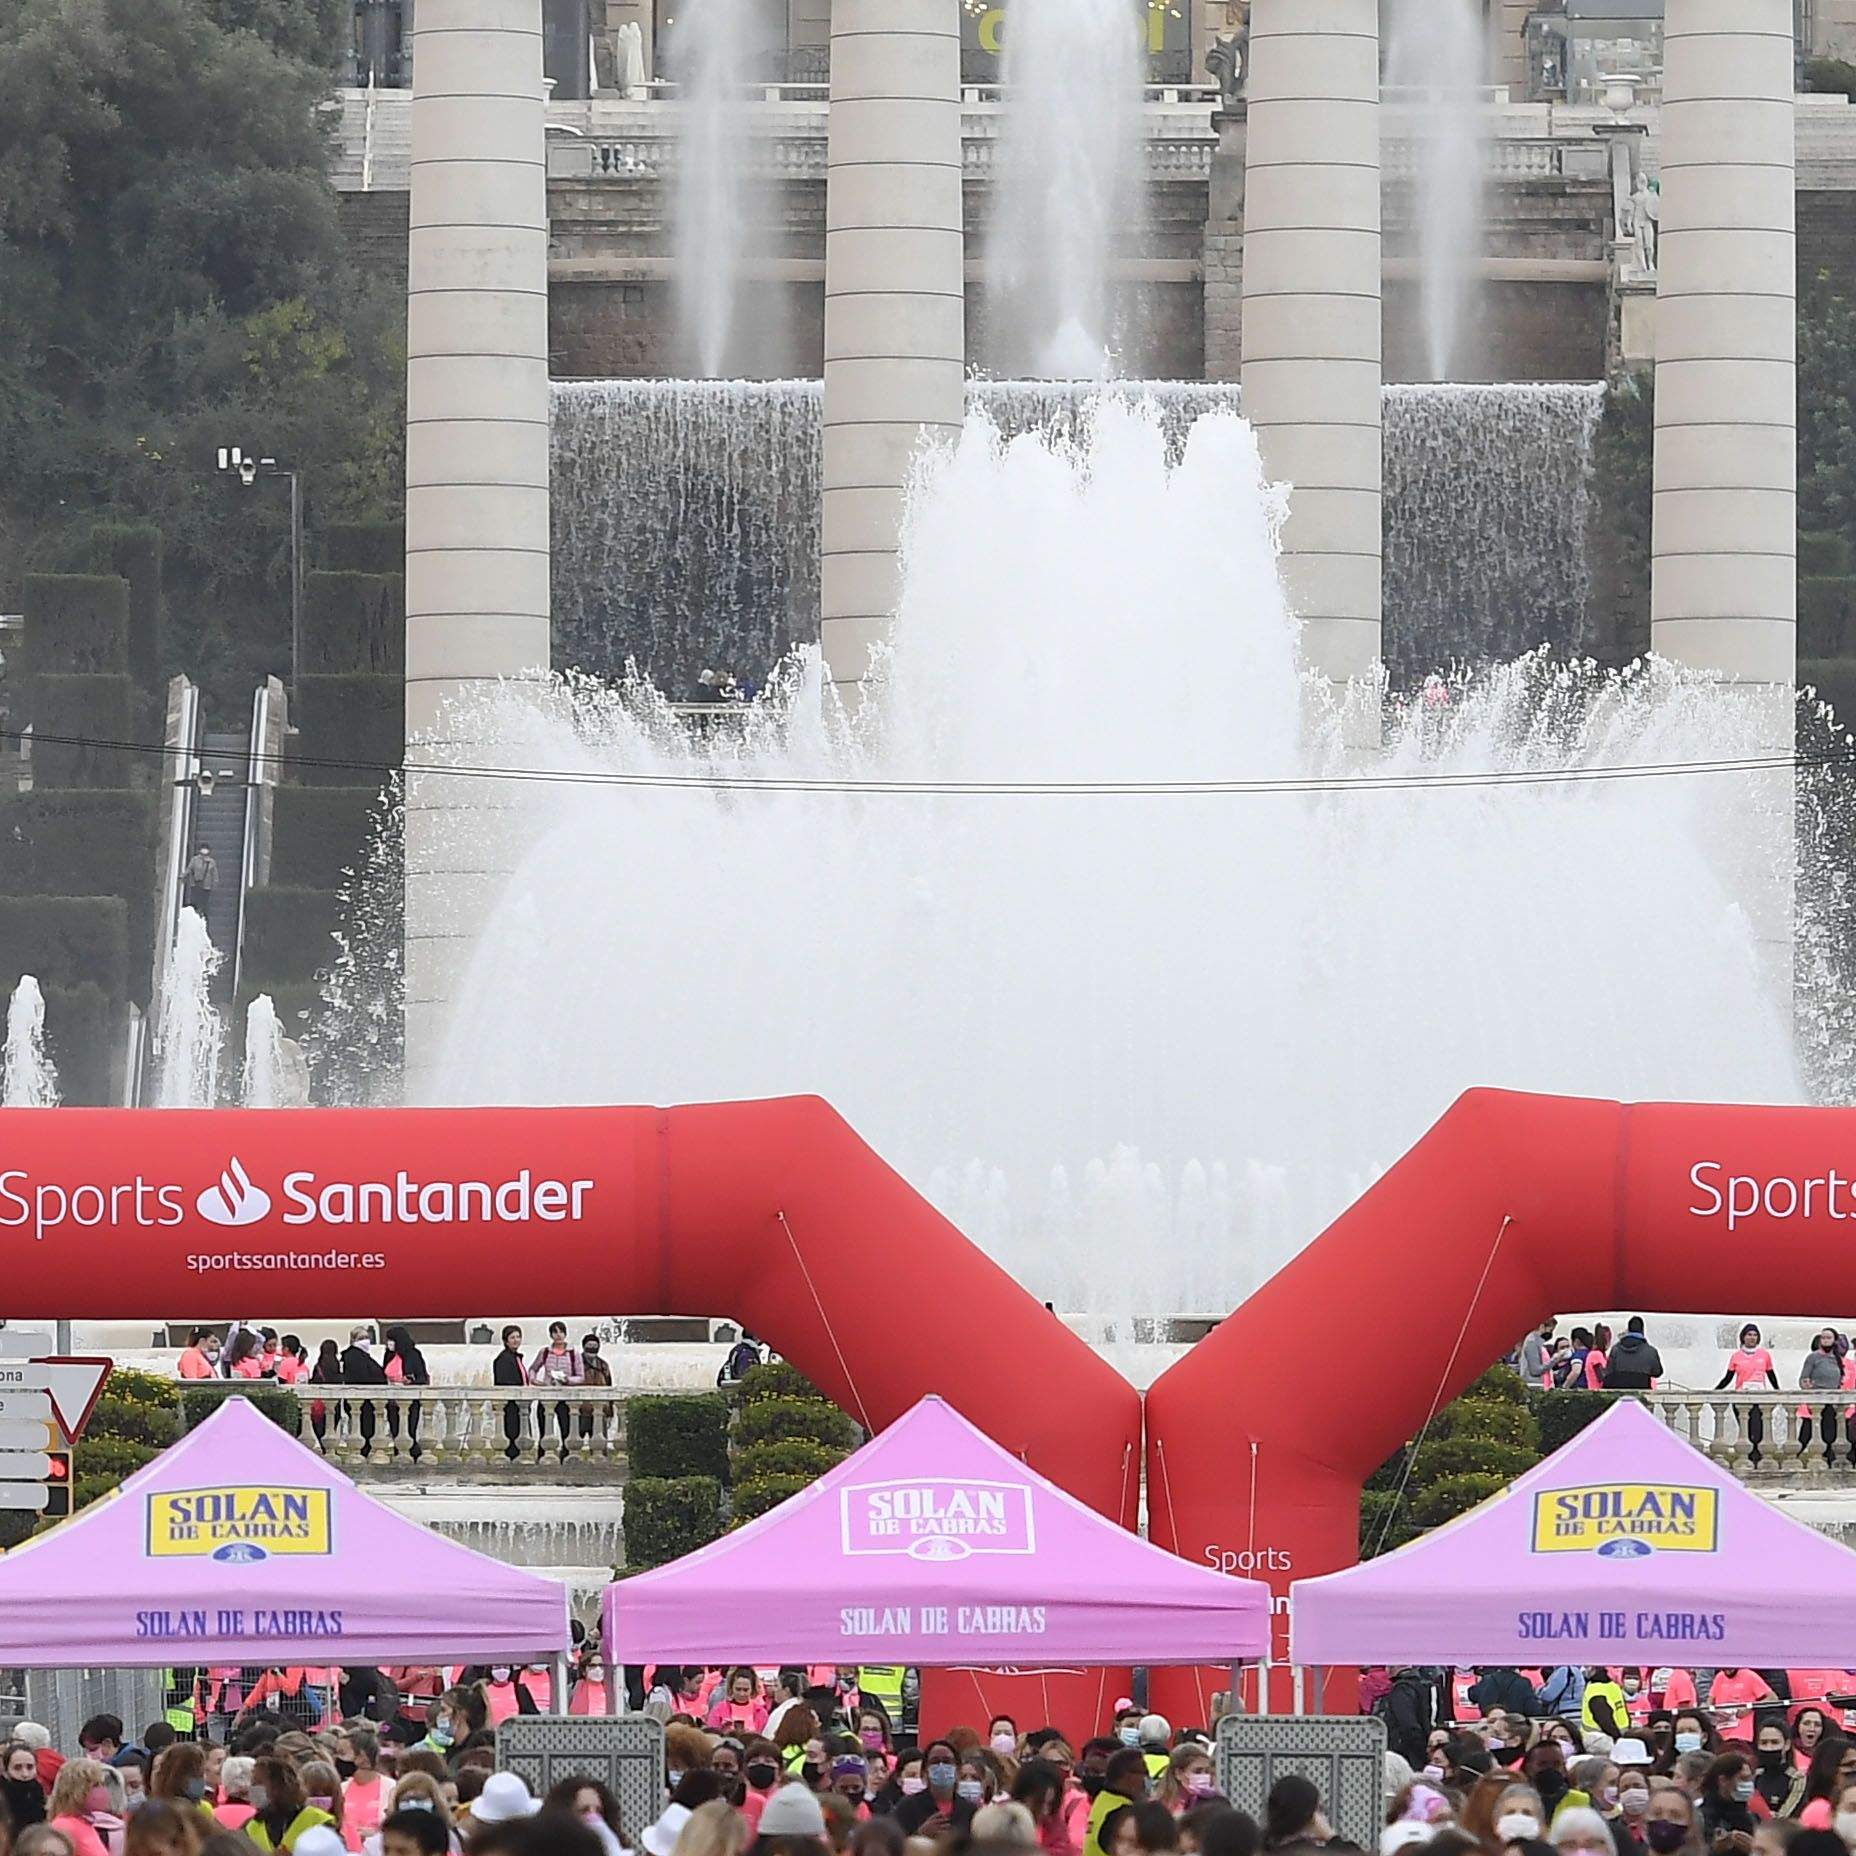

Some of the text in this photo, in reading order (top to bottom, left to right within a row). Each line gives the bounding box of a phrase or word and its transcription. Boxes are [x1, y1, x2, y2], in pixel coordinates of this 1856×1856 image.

[284, 1170, 593, 1223] Santander
[188, 1250, 384, 1272] sportssantander.es
[169, 1493, 308, 1524] SOLAN
[868, 1488, 1005, 1519] SOLAN
[1555, 1491, 1695, 1521] SOLAN
[170, 1523, 309, 1540] DE CABRAS
[869, 1518, 1007, 1536] DE CABRAS
[1555, 1520, 1695, 1537] DE CABRAS
[1205, 1545, 1292, 1575] Sports
[136, 1610, 342, 1637] SOLAN DE CABRAS
[840, 1606, 1046, 1636] SOLAN DE CABRAS
[1518, 1612, 1725, 1640] SOLAN DE CABRAS
